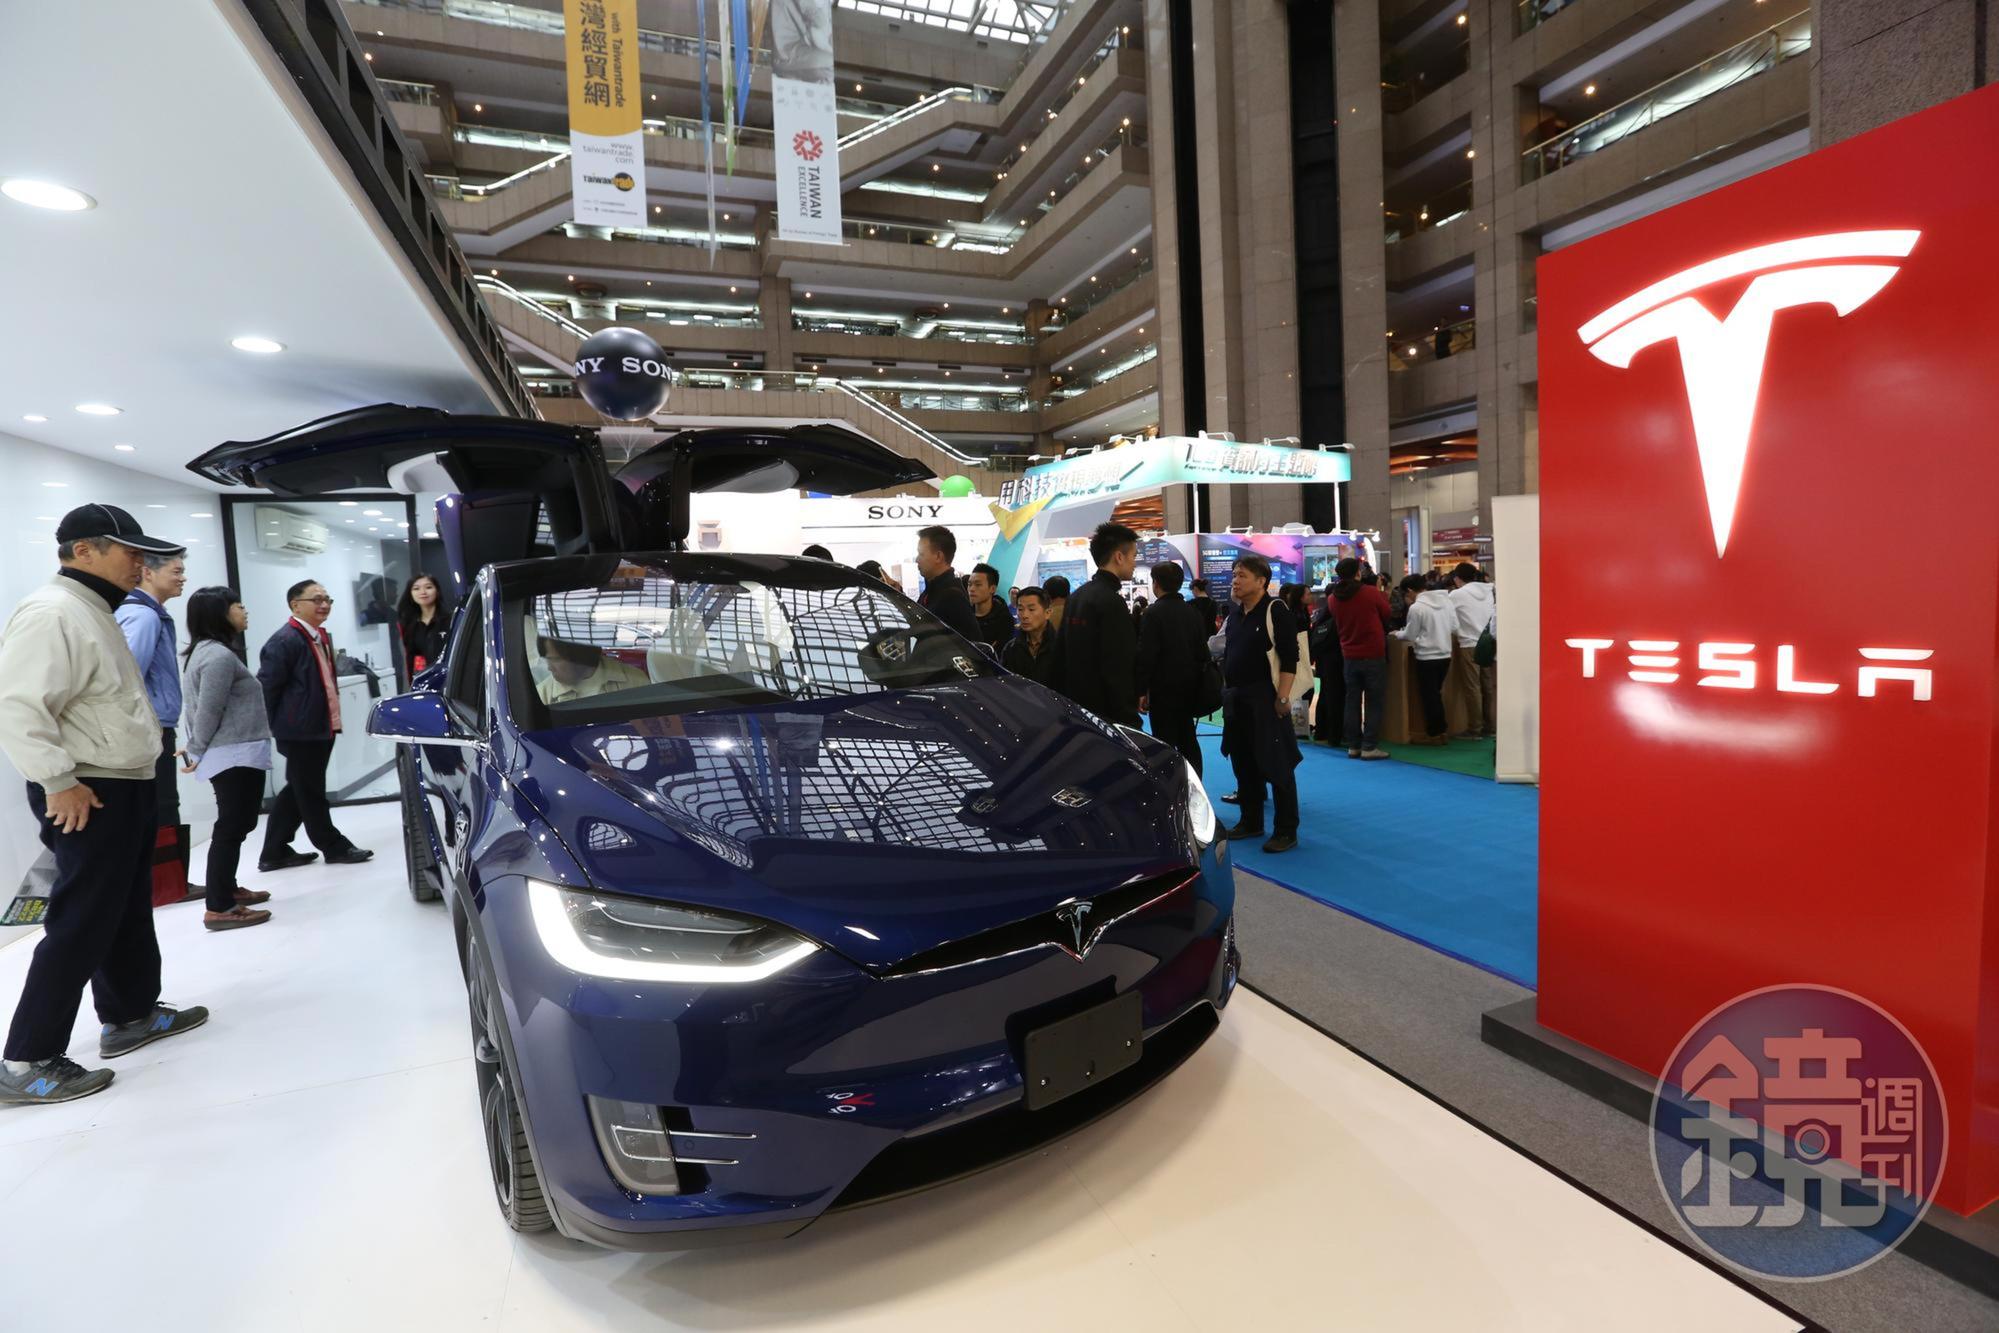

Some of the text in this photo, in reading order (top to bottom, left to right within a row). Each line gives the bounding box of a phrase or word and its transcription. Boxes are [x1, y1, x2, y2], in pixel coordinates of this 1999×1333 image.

[611, 12, 626, 108] with Taiwantrade
[798, 166, 808, 217] EXCELLENCE
[808, 166, 822, 219] TAIWAN
[868, 505, 943, 520] SONY
[1564, 638, 1935, 701] TESLA
